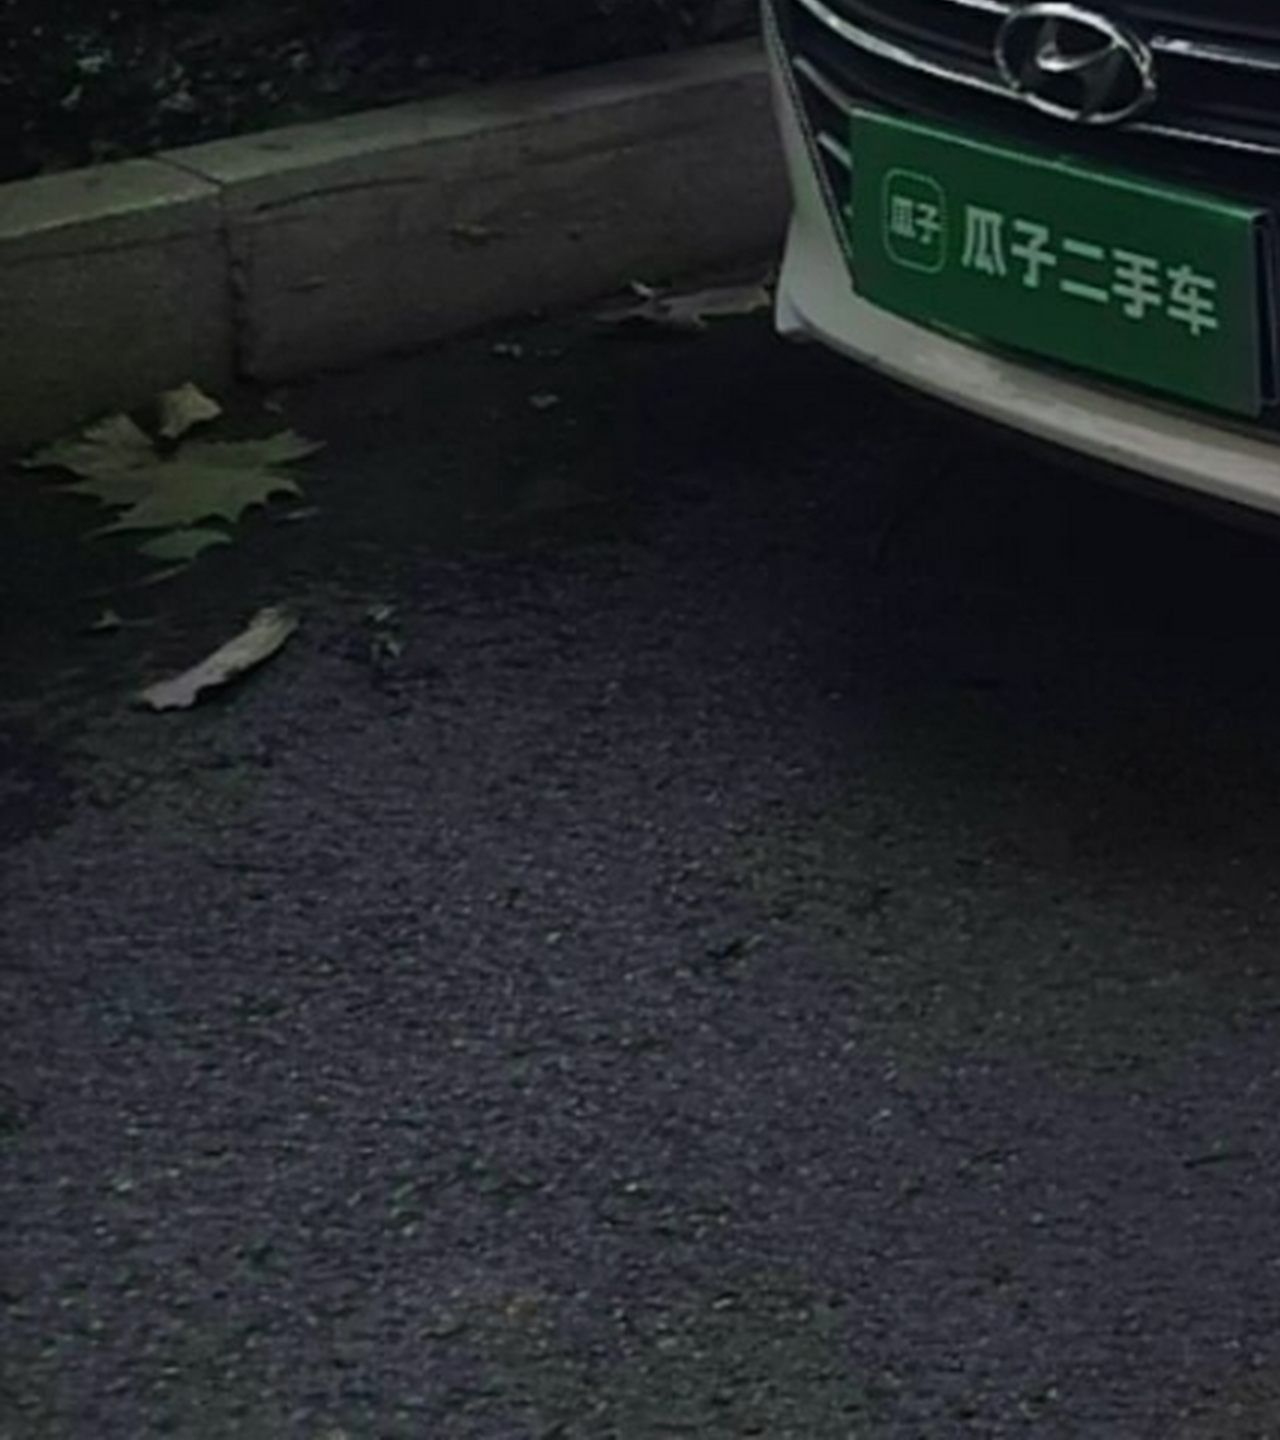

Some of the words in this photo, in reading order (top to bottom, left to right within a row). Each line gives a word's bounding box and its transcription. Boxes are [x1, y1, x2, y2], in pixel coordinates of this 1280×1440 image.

[962, 205, 1218, 335] 瓜子二手车
